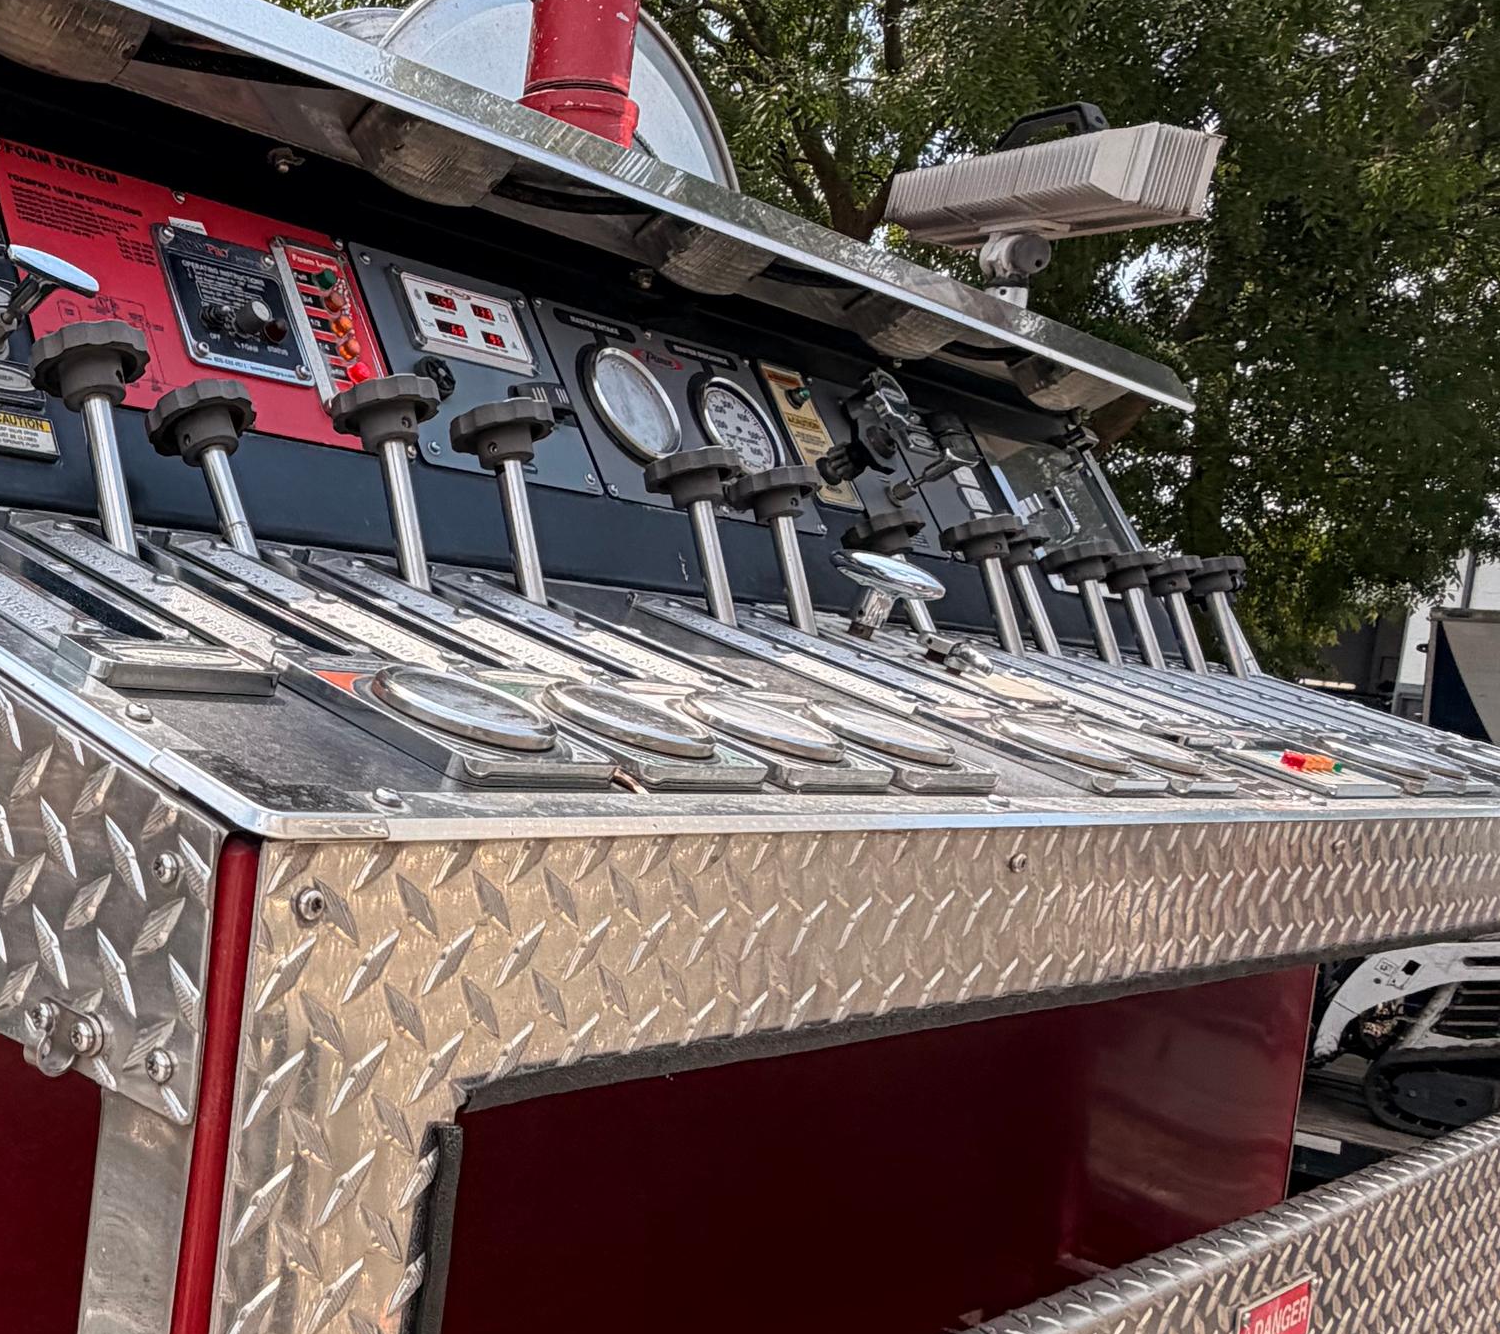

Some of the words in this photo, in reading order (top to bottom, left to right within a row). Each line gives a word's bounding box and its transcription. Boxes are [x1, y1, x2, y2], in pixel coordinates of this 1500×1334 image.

[3, 141, 50, 165] FOAM
[55, 156, 120, 186] SYSTEM
[291, 253, 315, 266] Foam
[193, 615, 247, 644] OPEN
